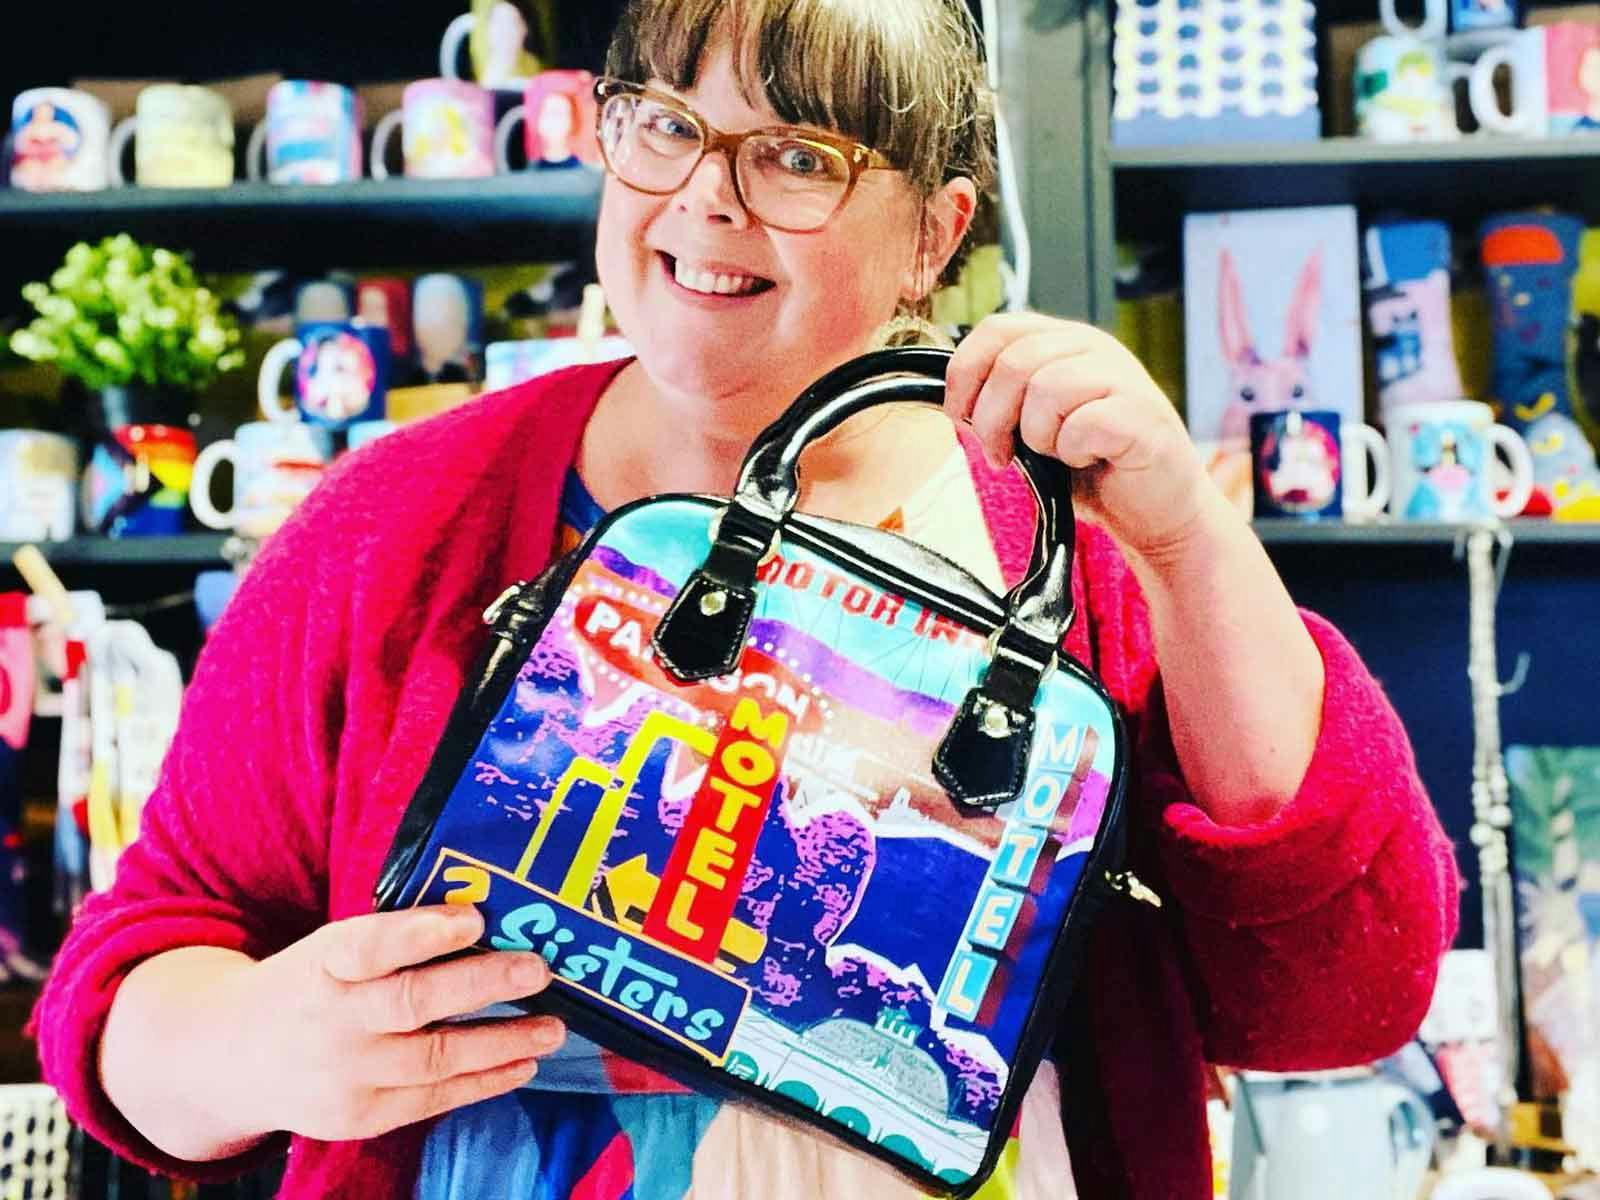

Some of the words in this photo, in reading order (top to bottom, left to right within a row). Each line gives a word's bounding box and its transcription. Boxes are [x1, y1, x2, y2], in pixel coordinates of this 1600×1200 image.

[914, 605, 988, 656] IN
[665, 697, 790, 941] MOTEL
[946, 722, 1079, 1015] MOTEL
[443, 866, 491, 904] 2
[491, 903, 725, 1041] Sisters
